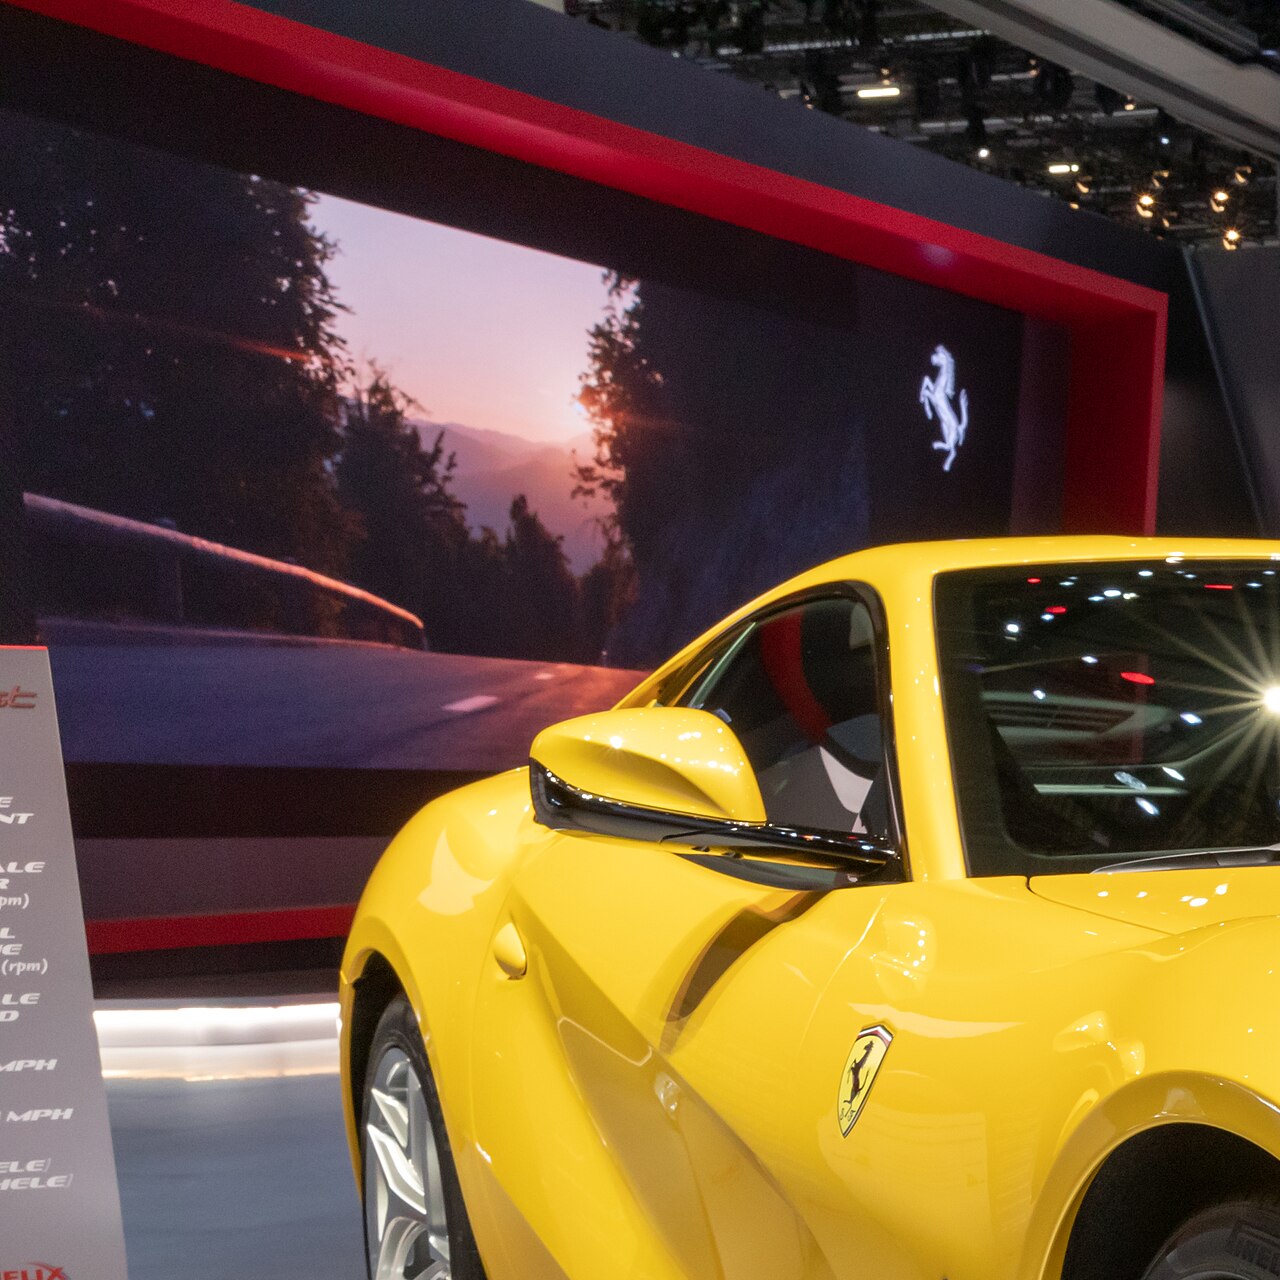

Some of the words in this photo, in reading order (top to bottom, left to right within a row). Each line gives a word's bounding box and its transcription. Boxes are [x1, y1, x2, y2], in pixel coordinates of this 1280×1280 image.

[0, 861, 45, 874] LE
[2, 958, 48, 976] (rpm)
[6, 1107, 73, 1122] MPH
